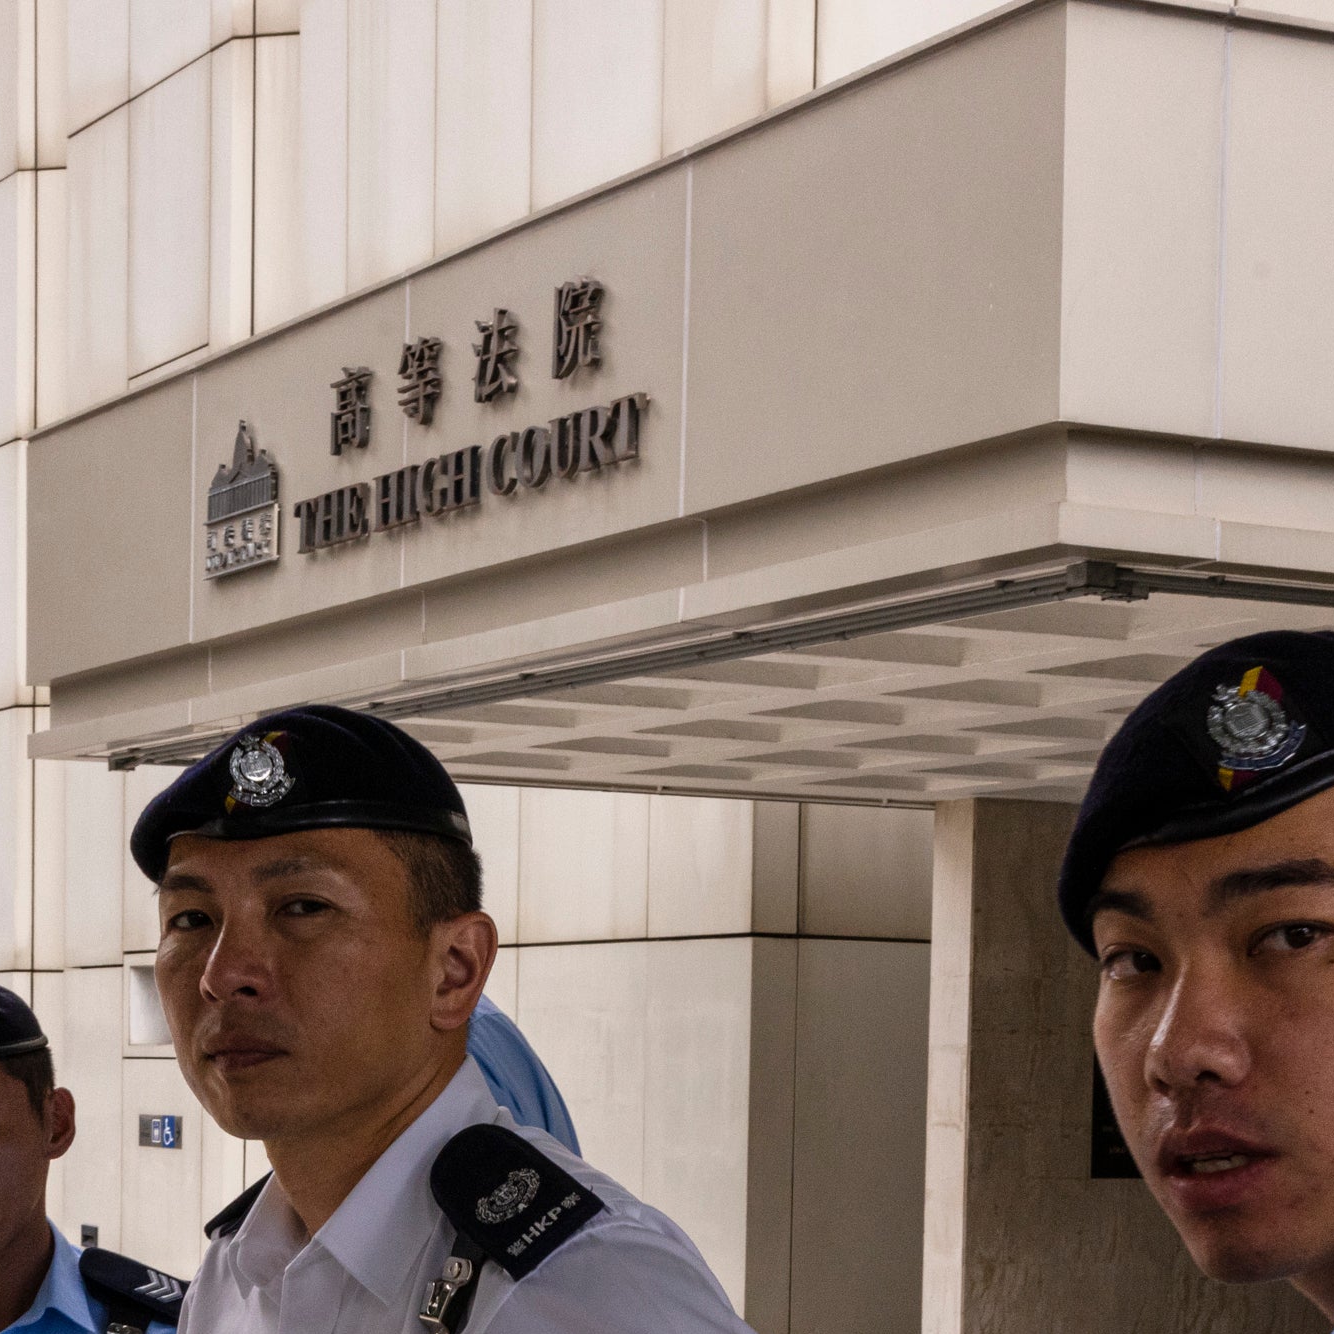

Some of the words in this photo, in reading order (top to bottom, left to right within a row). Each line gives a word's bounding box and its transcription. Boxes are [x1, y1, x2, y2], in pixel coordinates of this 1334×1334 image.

[329, 275, 605, 456] 高等法院
[293, 482, 369, 554] THE
[373, 444, 482, 532] HIGH
[486, 391, 651, 497] COURT
[522, 1207, 562, 1244] HKP
